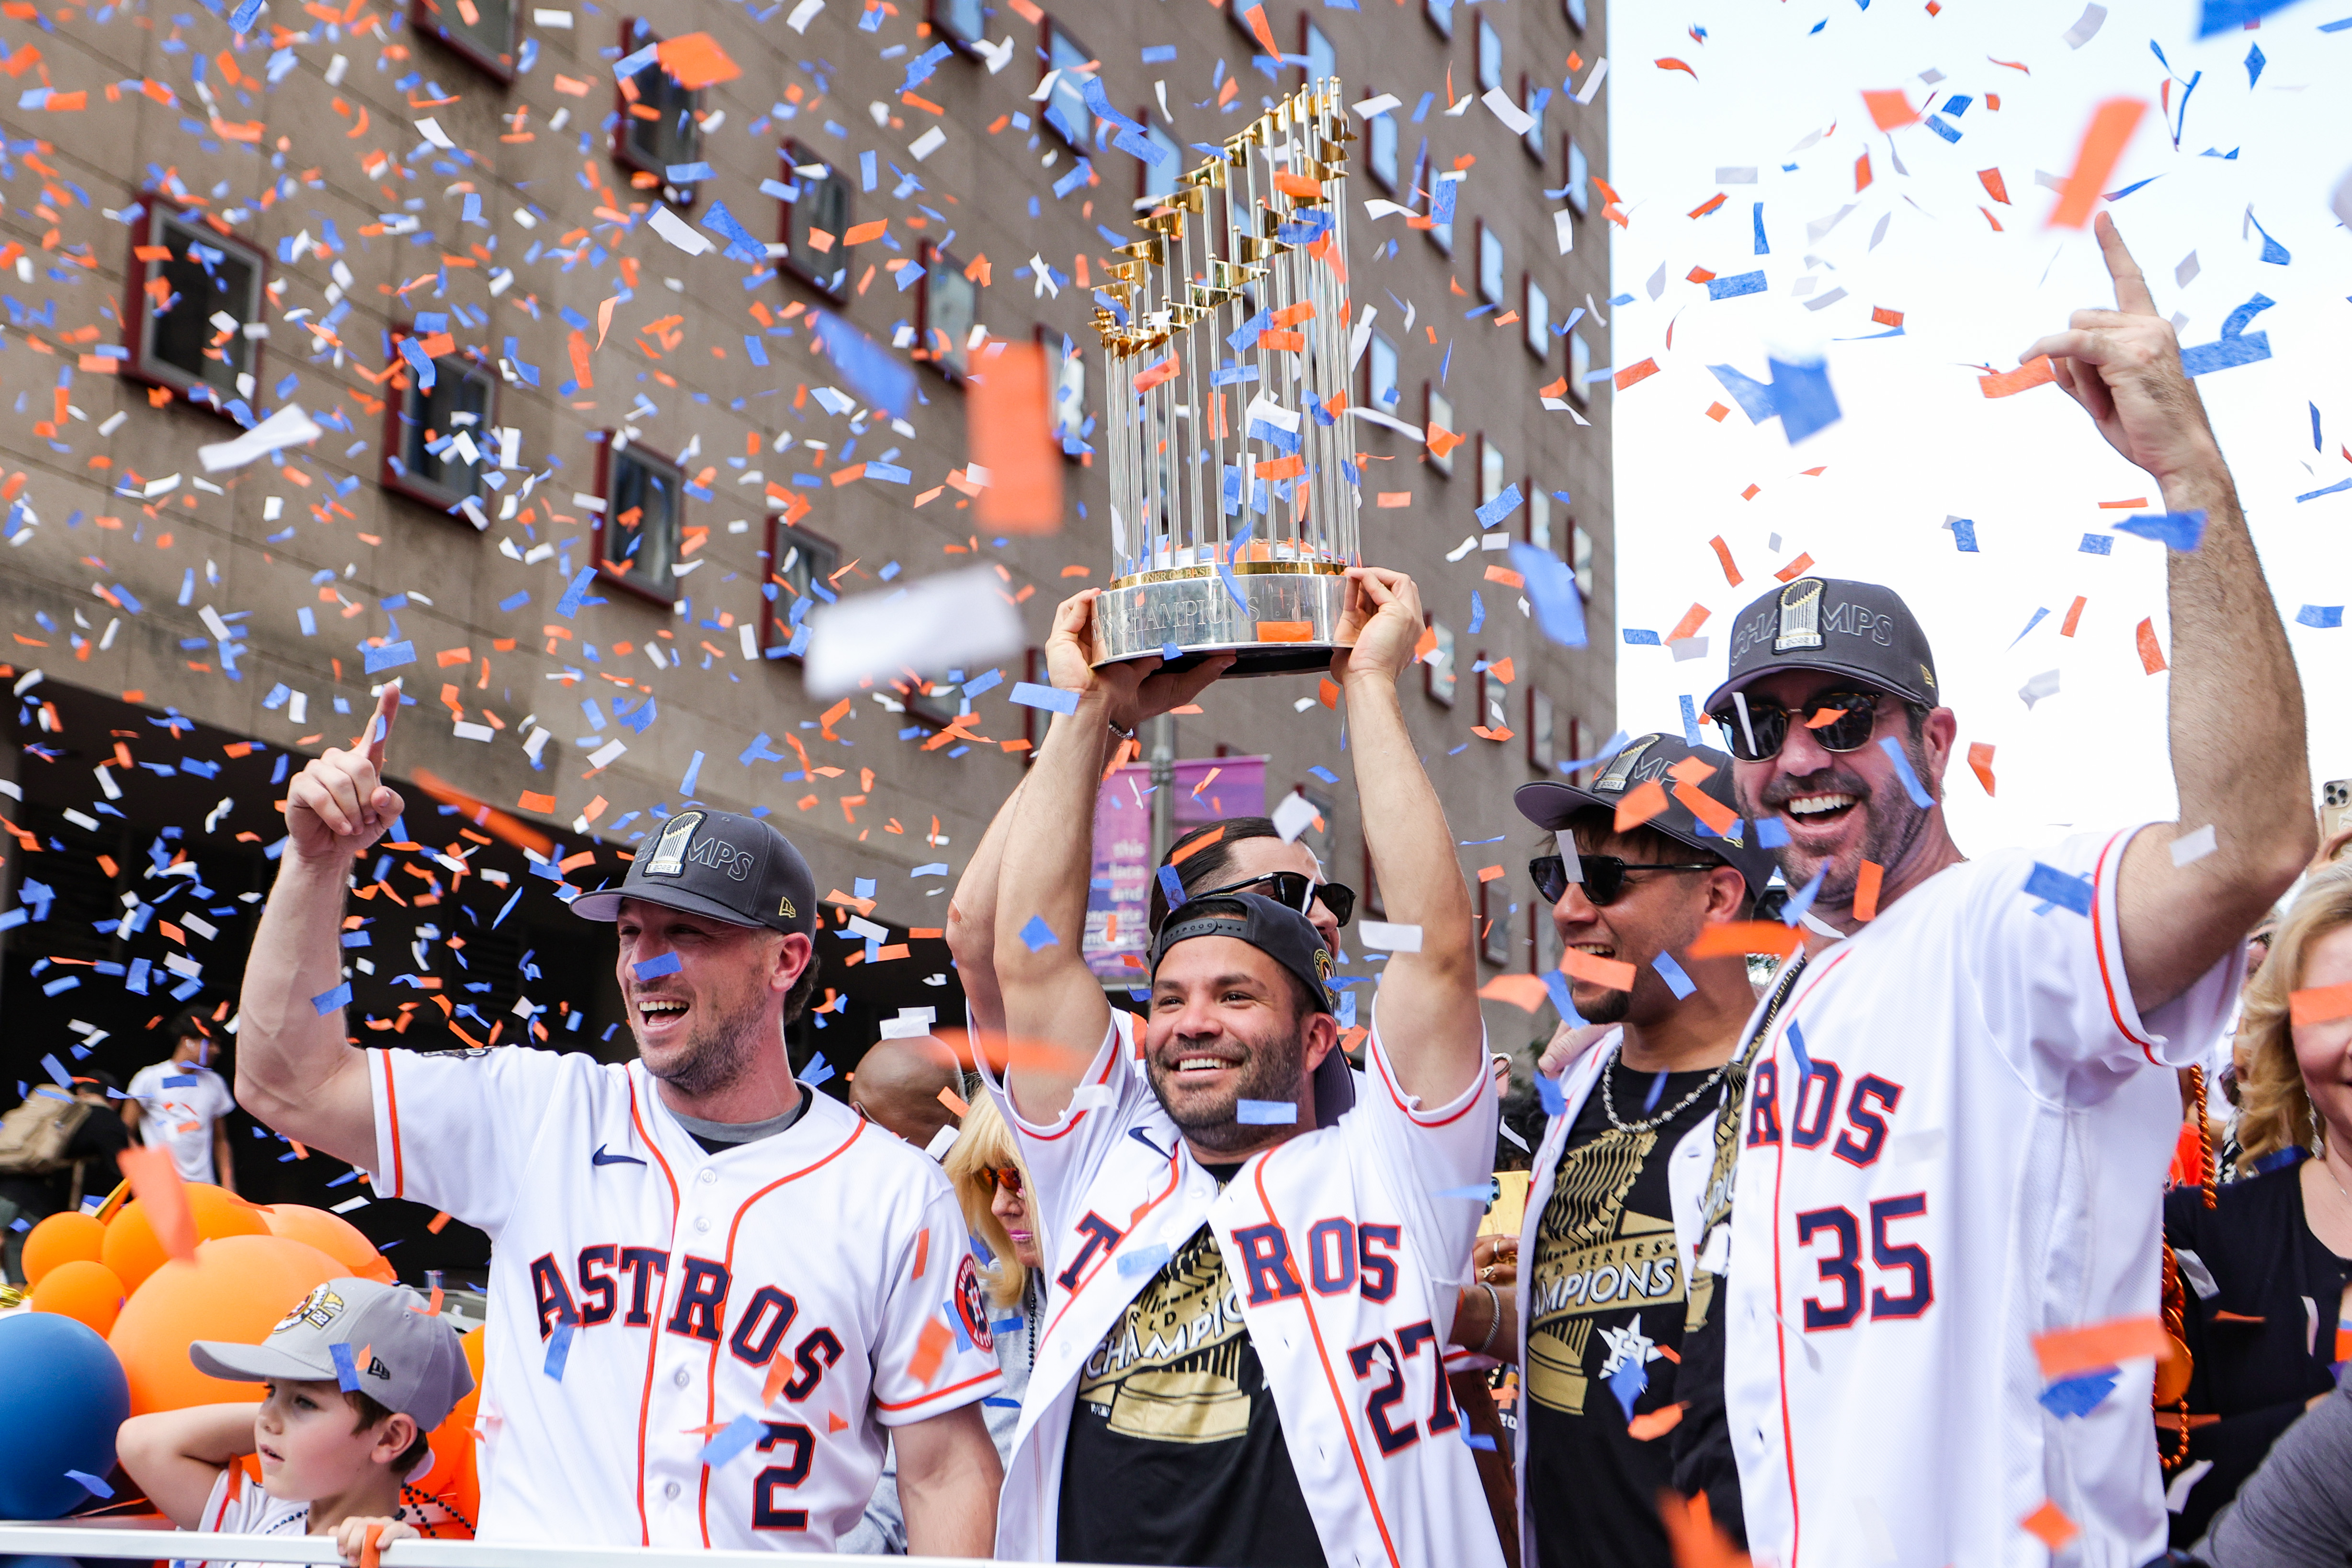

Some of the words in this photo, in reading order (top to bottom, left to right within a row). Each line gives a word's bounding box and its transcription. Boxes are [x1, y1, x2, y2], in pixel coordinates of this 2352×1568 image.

[1117, 596, 1261, 634] CHAMPIONS
[1746, 1057, 1905, 1169] ROS
[958, 1258, 978, 1293] HOUSTO
[1230, 1216, 1402, 1309] ROS
[1576, 1240, 1662, 1269] SERIES
[1796, 1191, 1934, 1333] 35
[310, 1310, 330, 1325] 22
[530, 1244, 844, 1403] ASTROS
[1347, 1319, 1460, 1458] 27
[751, 1420, 816, 1532] 2
